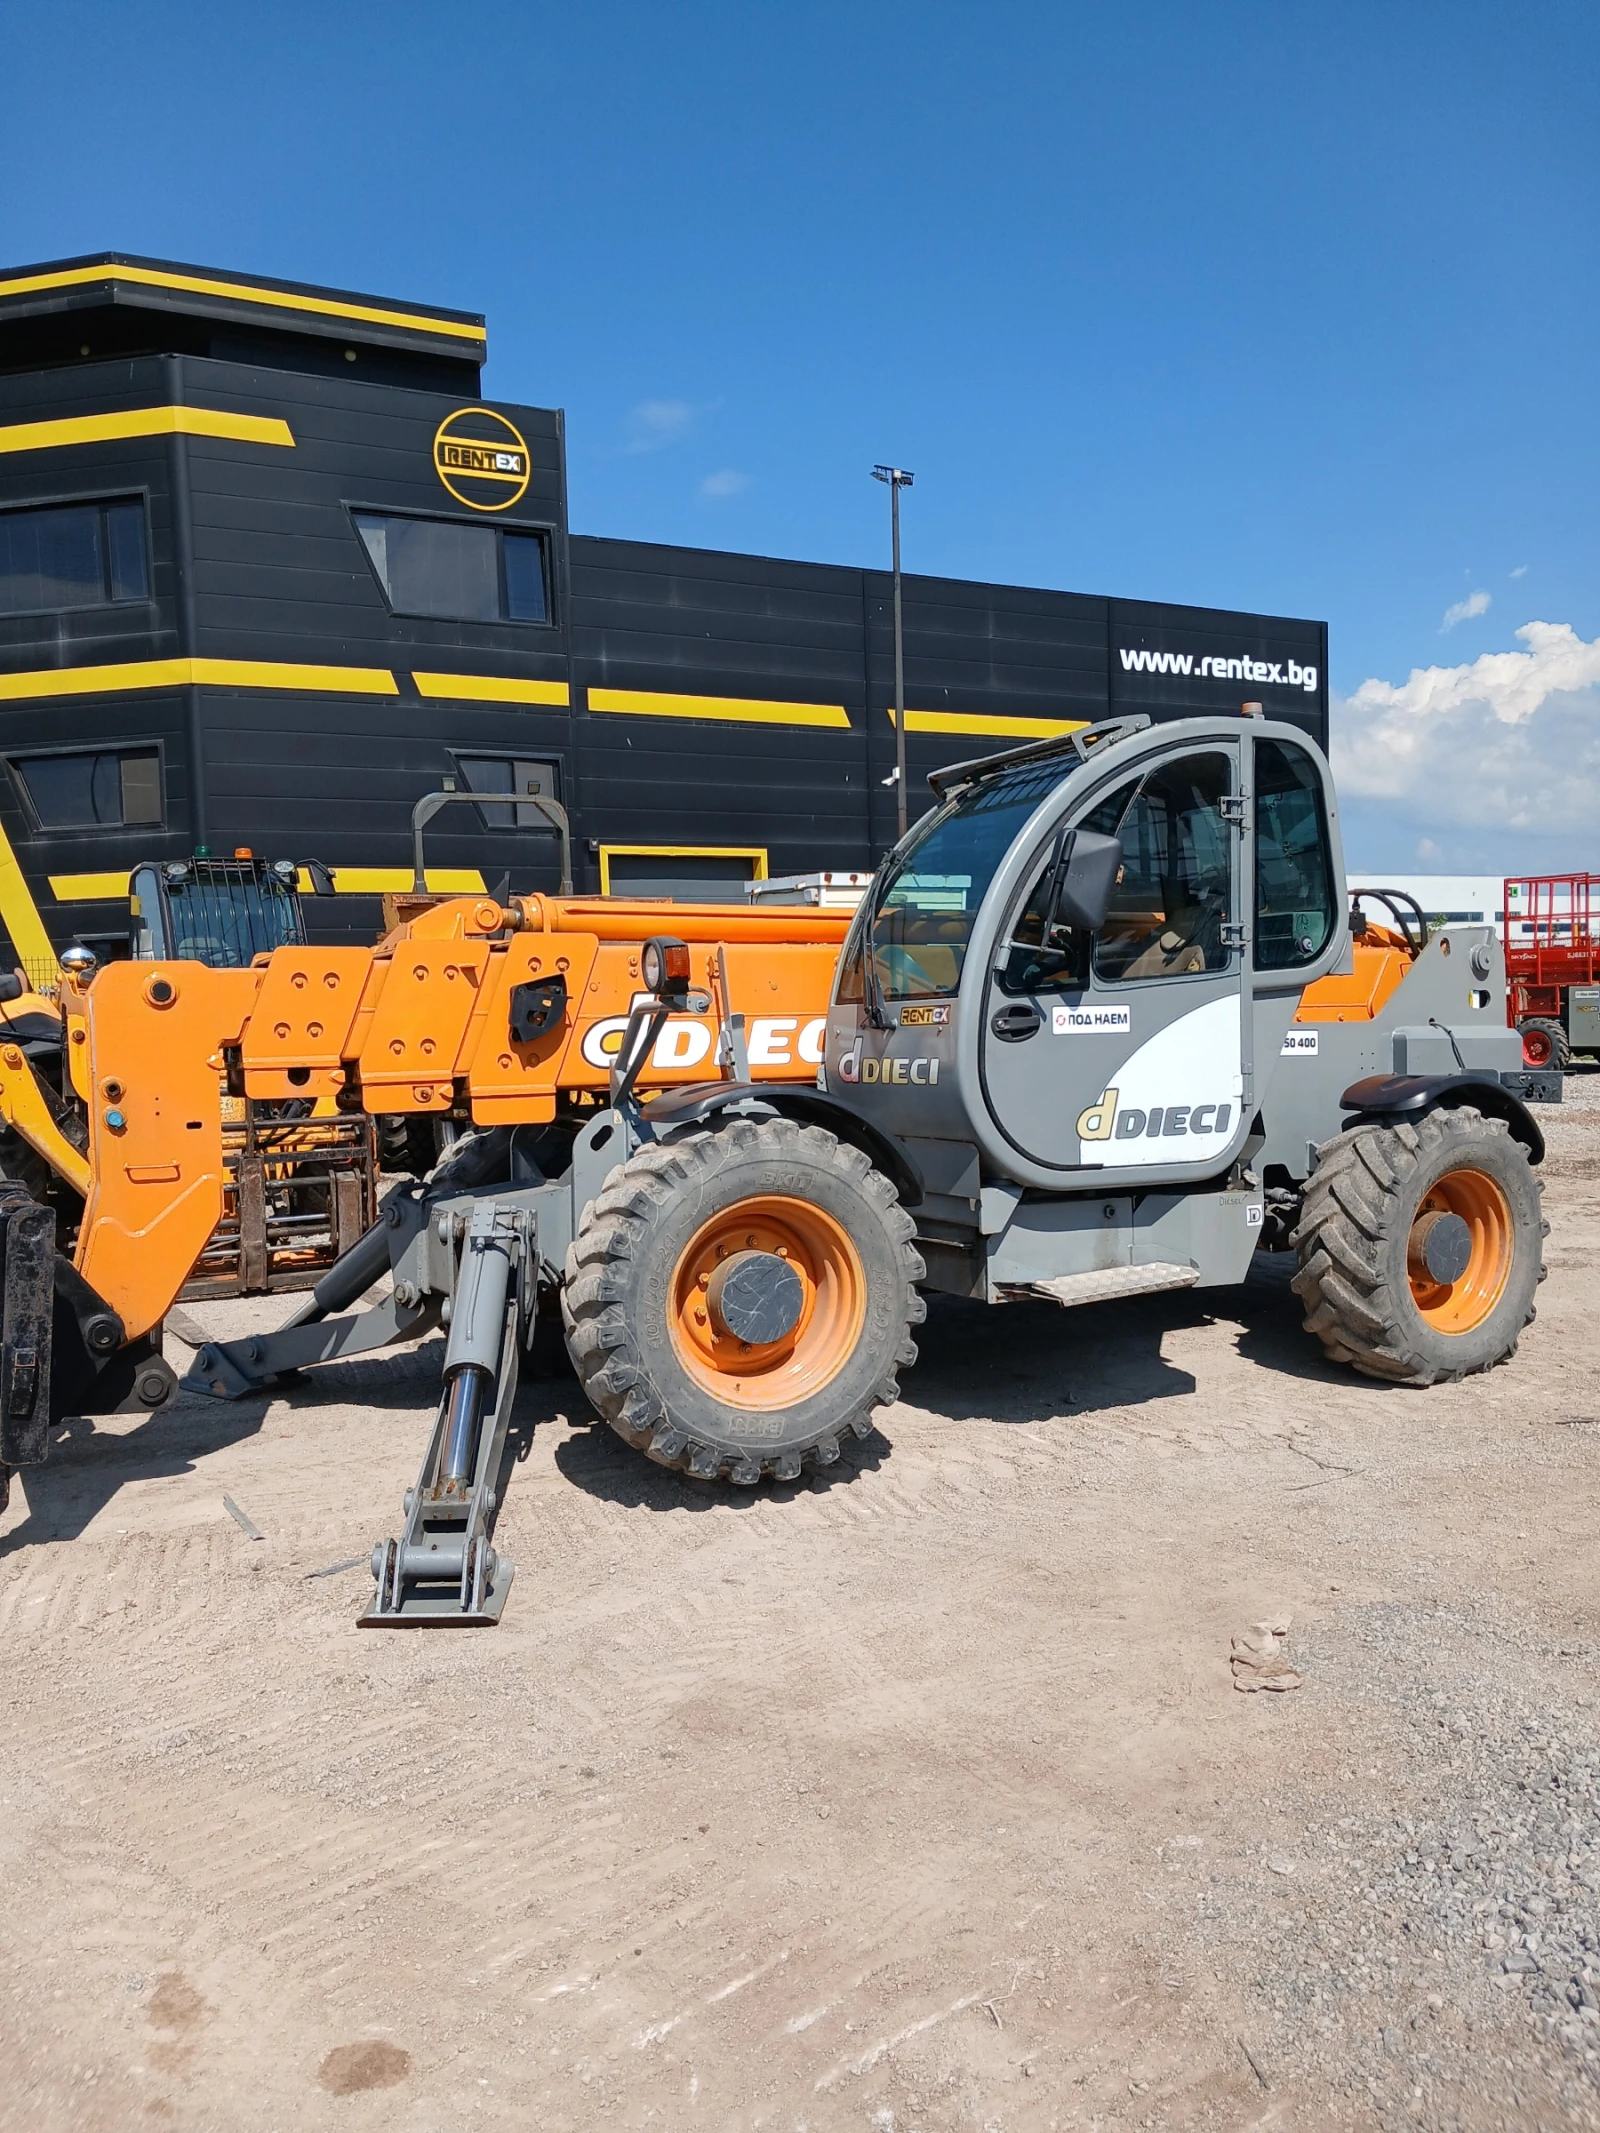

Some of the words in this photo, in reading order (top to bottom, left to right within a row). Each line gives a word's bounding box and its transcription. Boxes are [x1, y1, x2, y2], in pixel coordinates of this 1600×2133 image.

[444, 445, 521, 472] RENTEX
[1119, 649, 1317, 692] www.rentex.bg
[901, 1007, 949, 1024] RENTEX
[1068, 1013, 1092, 1026] ПОД
[1094, 1013, 1128, 1025] НАЕМ
[1297, 1037, 1316, 1048] 400
[758, 1168, 815, 1192] BKT
